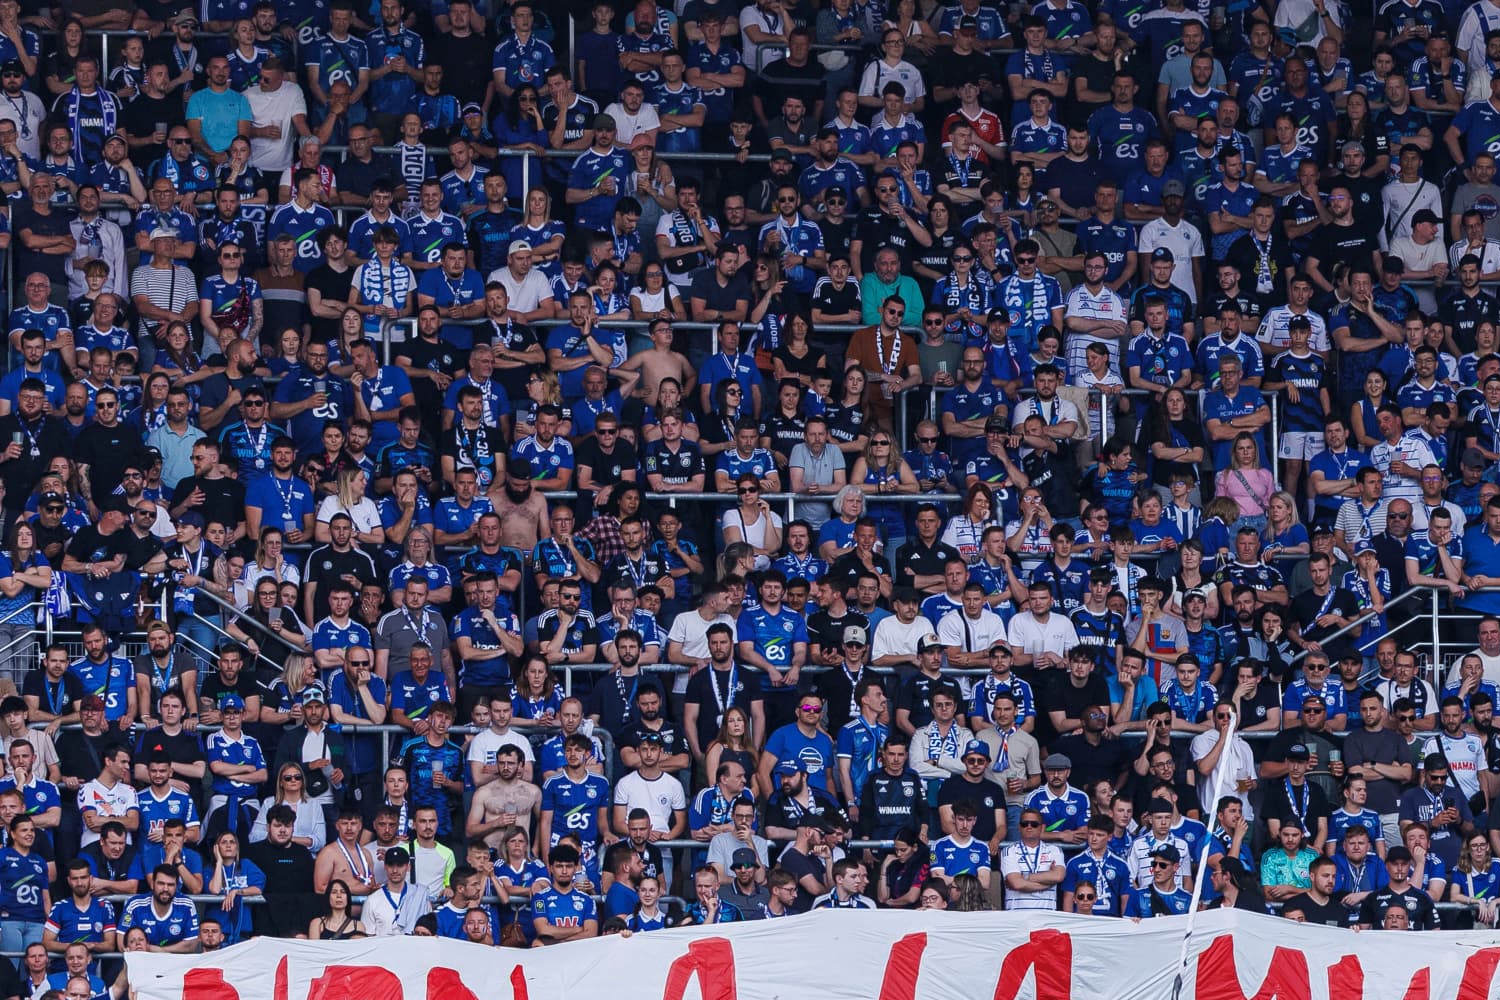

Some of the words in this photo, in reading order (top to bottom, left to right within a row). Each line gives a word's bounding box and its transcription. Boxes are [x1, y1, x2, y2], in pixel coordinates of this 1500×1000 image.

[1296, 124, 1319, 145] es
[1116, 143, 1138, 158] es
[299, 242, 321, 259] es
[765, 644, 787, 661] es
[878, 806, 911, 815] WINAMAX
[567, 812, 590, 829] es
[17, 884, 40, 905] es
